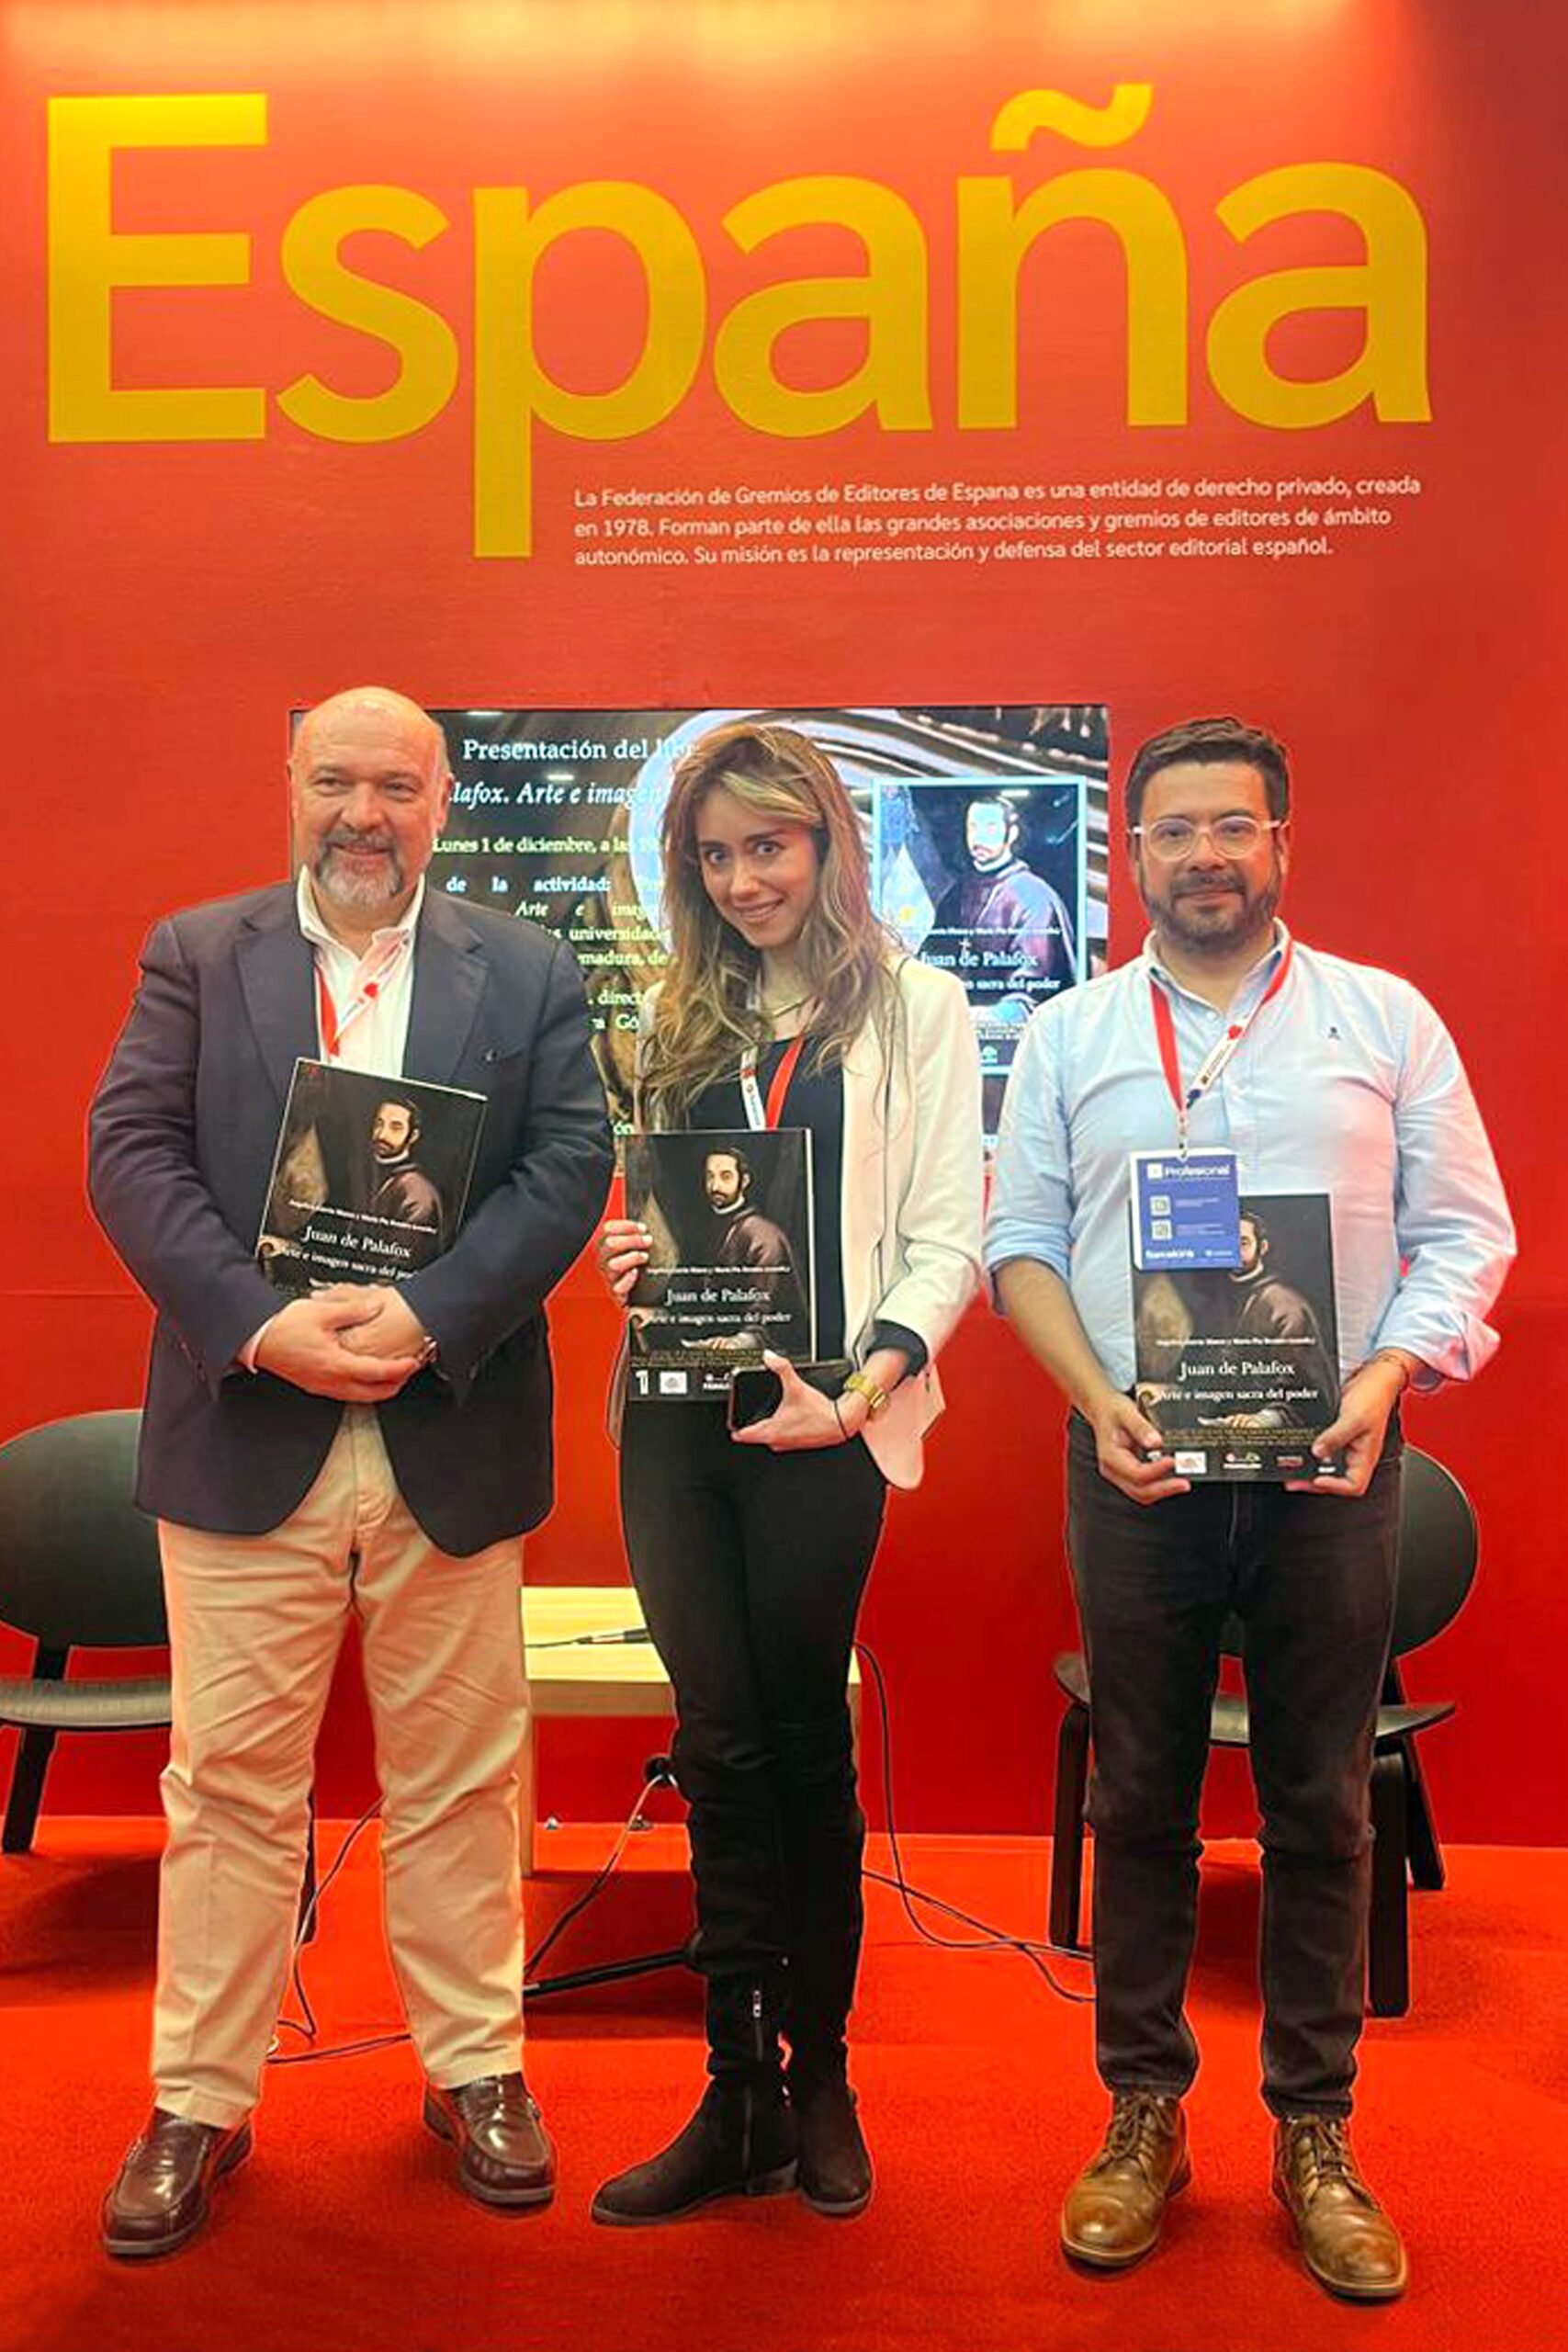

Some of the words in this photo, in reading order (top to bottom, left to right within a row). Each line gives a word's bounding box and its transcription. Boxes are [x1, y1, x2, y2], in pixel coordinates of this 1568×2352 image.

[47, 84, 1433, 559] España
[574, 489, 597, 507] La
[602, 487, 705, 506] Federación
[708, 487, 731, 505] de
[736, 486, 812, 504] Gremios
[816, 485, 839, 503] de
[844, 483, 919, 503] Editores
[924, 483, 948, 502] de
[1024, 486, 1045, 500] es
[1050, 485, 1085, 499] una
[1089, 479, 1161, 498] entidad
[1166, 479, 1190, 497] de
[1194, 478, 1271, 497] derecho
[1277, 477, 1351, 501] privado,
[1355, 476, 1421, 495] creada
[574, 522, 597, 537] en
[604, 518, 654, 537] 1978.
[660, 517, 730, 536] Forman
[735, 518, 784, 540] parte
[788, 515, 811, 535] de
[816, 515, 852, 534] ella
[855, 514, 883, 533] las
[887, 514, 962, 537] grandes
[965, 512, 1084, 531] asociaciones
[1089, 514, 1100, 532] y
[1105, 509, 1180, 532] gremios
[1184, 508, 1209, 526] de
[1213, 507, 1290, 526] editores
[1294, 506, 1318, 526] de
[1323, 506, 1392, 526] ámbito
[574, 547, 689, 566] autonómico.
[694, 546, 717, 564] Su
[721, 545, 783, 564] misión
[786, 548, 807, 562] es
[812, 544, 831, 561] la
[834, 543, 974, 565] representación
[977, 546, 990, 563] y
[994, 540, 1067, 559] defensa
[1071, 539, 1100, 558] del
[1105, 541, 1165, 558] sector
[1169, 537, 1247, 557] editorial
[1253, 536, 1335, 560] español.
[463, 739, 607, 761] Presentación
[614, 739, 649, 760] del
[448, 781, 510, 809] lafox.
[516, 783, 563, 804] Arte
[570, 789, 581, 804] e
[433, 837, 479, 854] Lunes
[481, 837, 491, 854] 1
[493, 836, 513, 854] de
[516, 836, 597, 855] diciembre,
[600, 840, 610, 853] a
[446, 876, 468, 893] de
[491, 876, 508, 893] la
[534, 876, 612, 893] actividad:
[515, 901, 549, 917] Arte
[958, 950, 979, 967] de
[983, 950, 1038, 967] Palafox
[300, 1226, 337, 1245] Juan
[340, 1233, 358, 1249] de
[362, 1237, 412, 1259] Palafox
[664, 1288, 698, 1306] Juan
[700, 1288, 718, 1303] de
[721, 1287, 772, 1303] Palafox
[761, 1311, 793, 1326] poder
[1179, 1361, 1215, 1381] Juan
[1219, 1360, 1238, 1376] de
[1242, 1360, 1296, 1376] Palafox
[1285, 1386, 1319, 1403] poder
